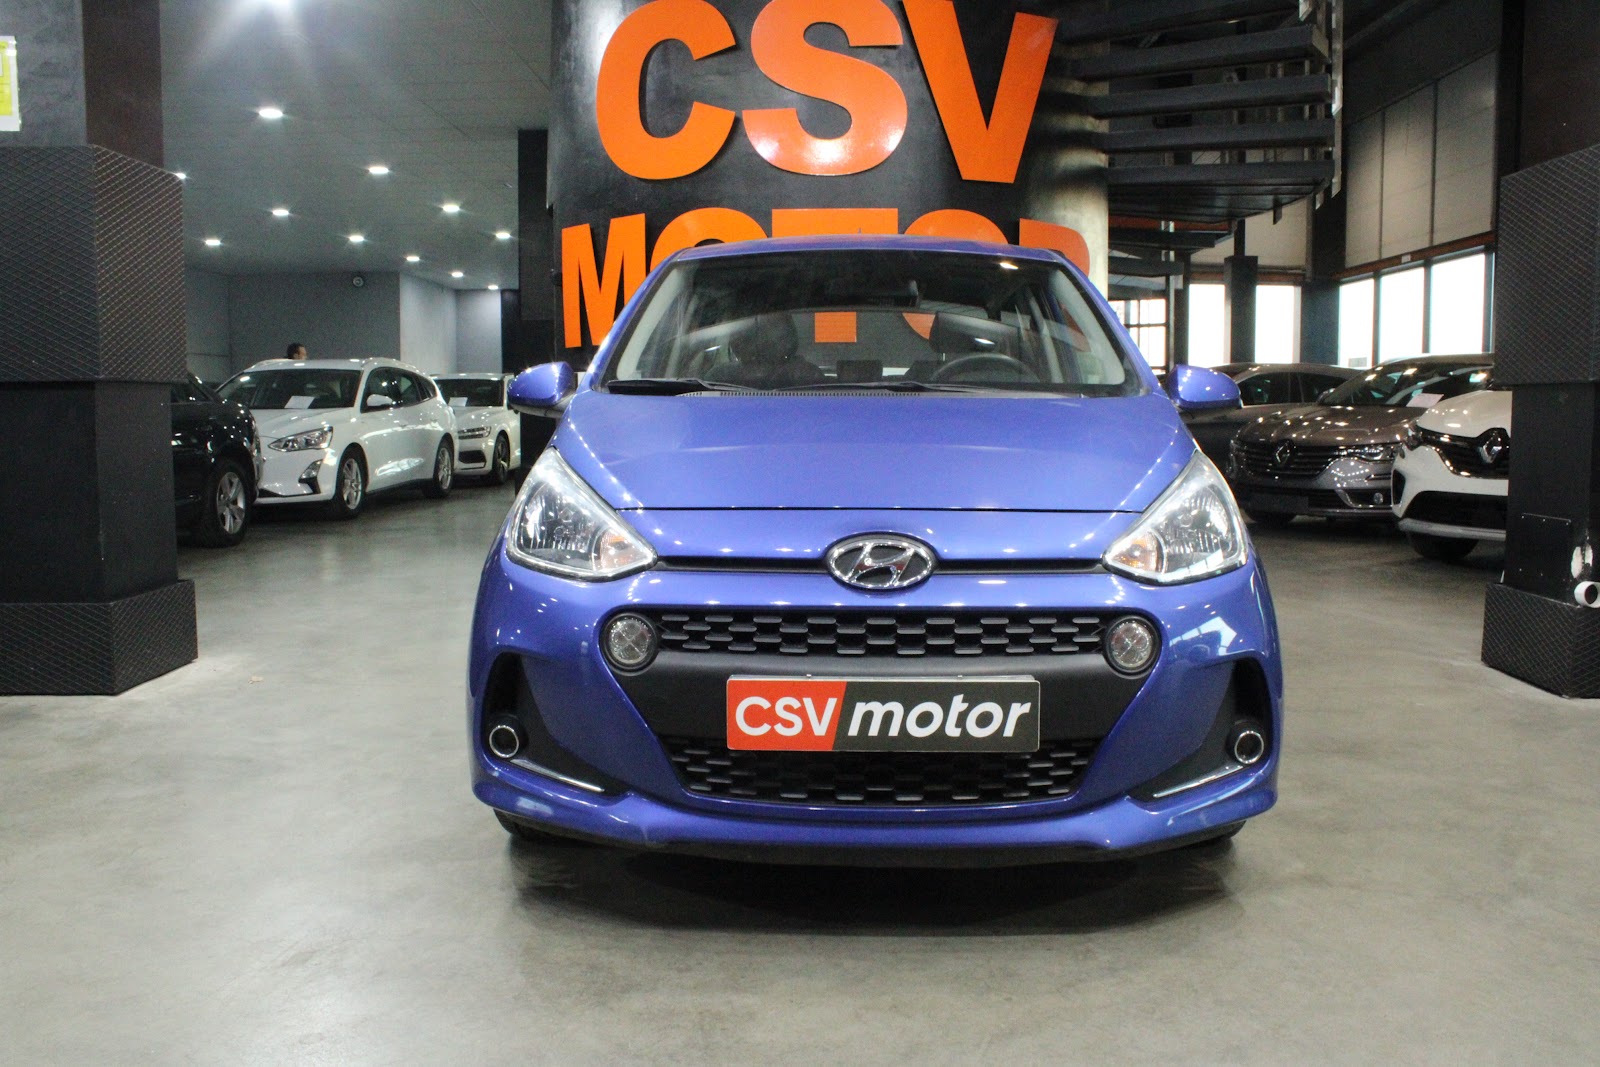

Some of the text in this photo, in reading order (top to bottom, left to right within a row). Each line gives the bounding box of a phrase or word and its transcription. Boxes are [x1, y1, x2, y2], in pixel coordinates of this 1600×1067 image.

[596, 0, 1058, 184] CSV
[735, 693, 1032, 738] CSV motor
